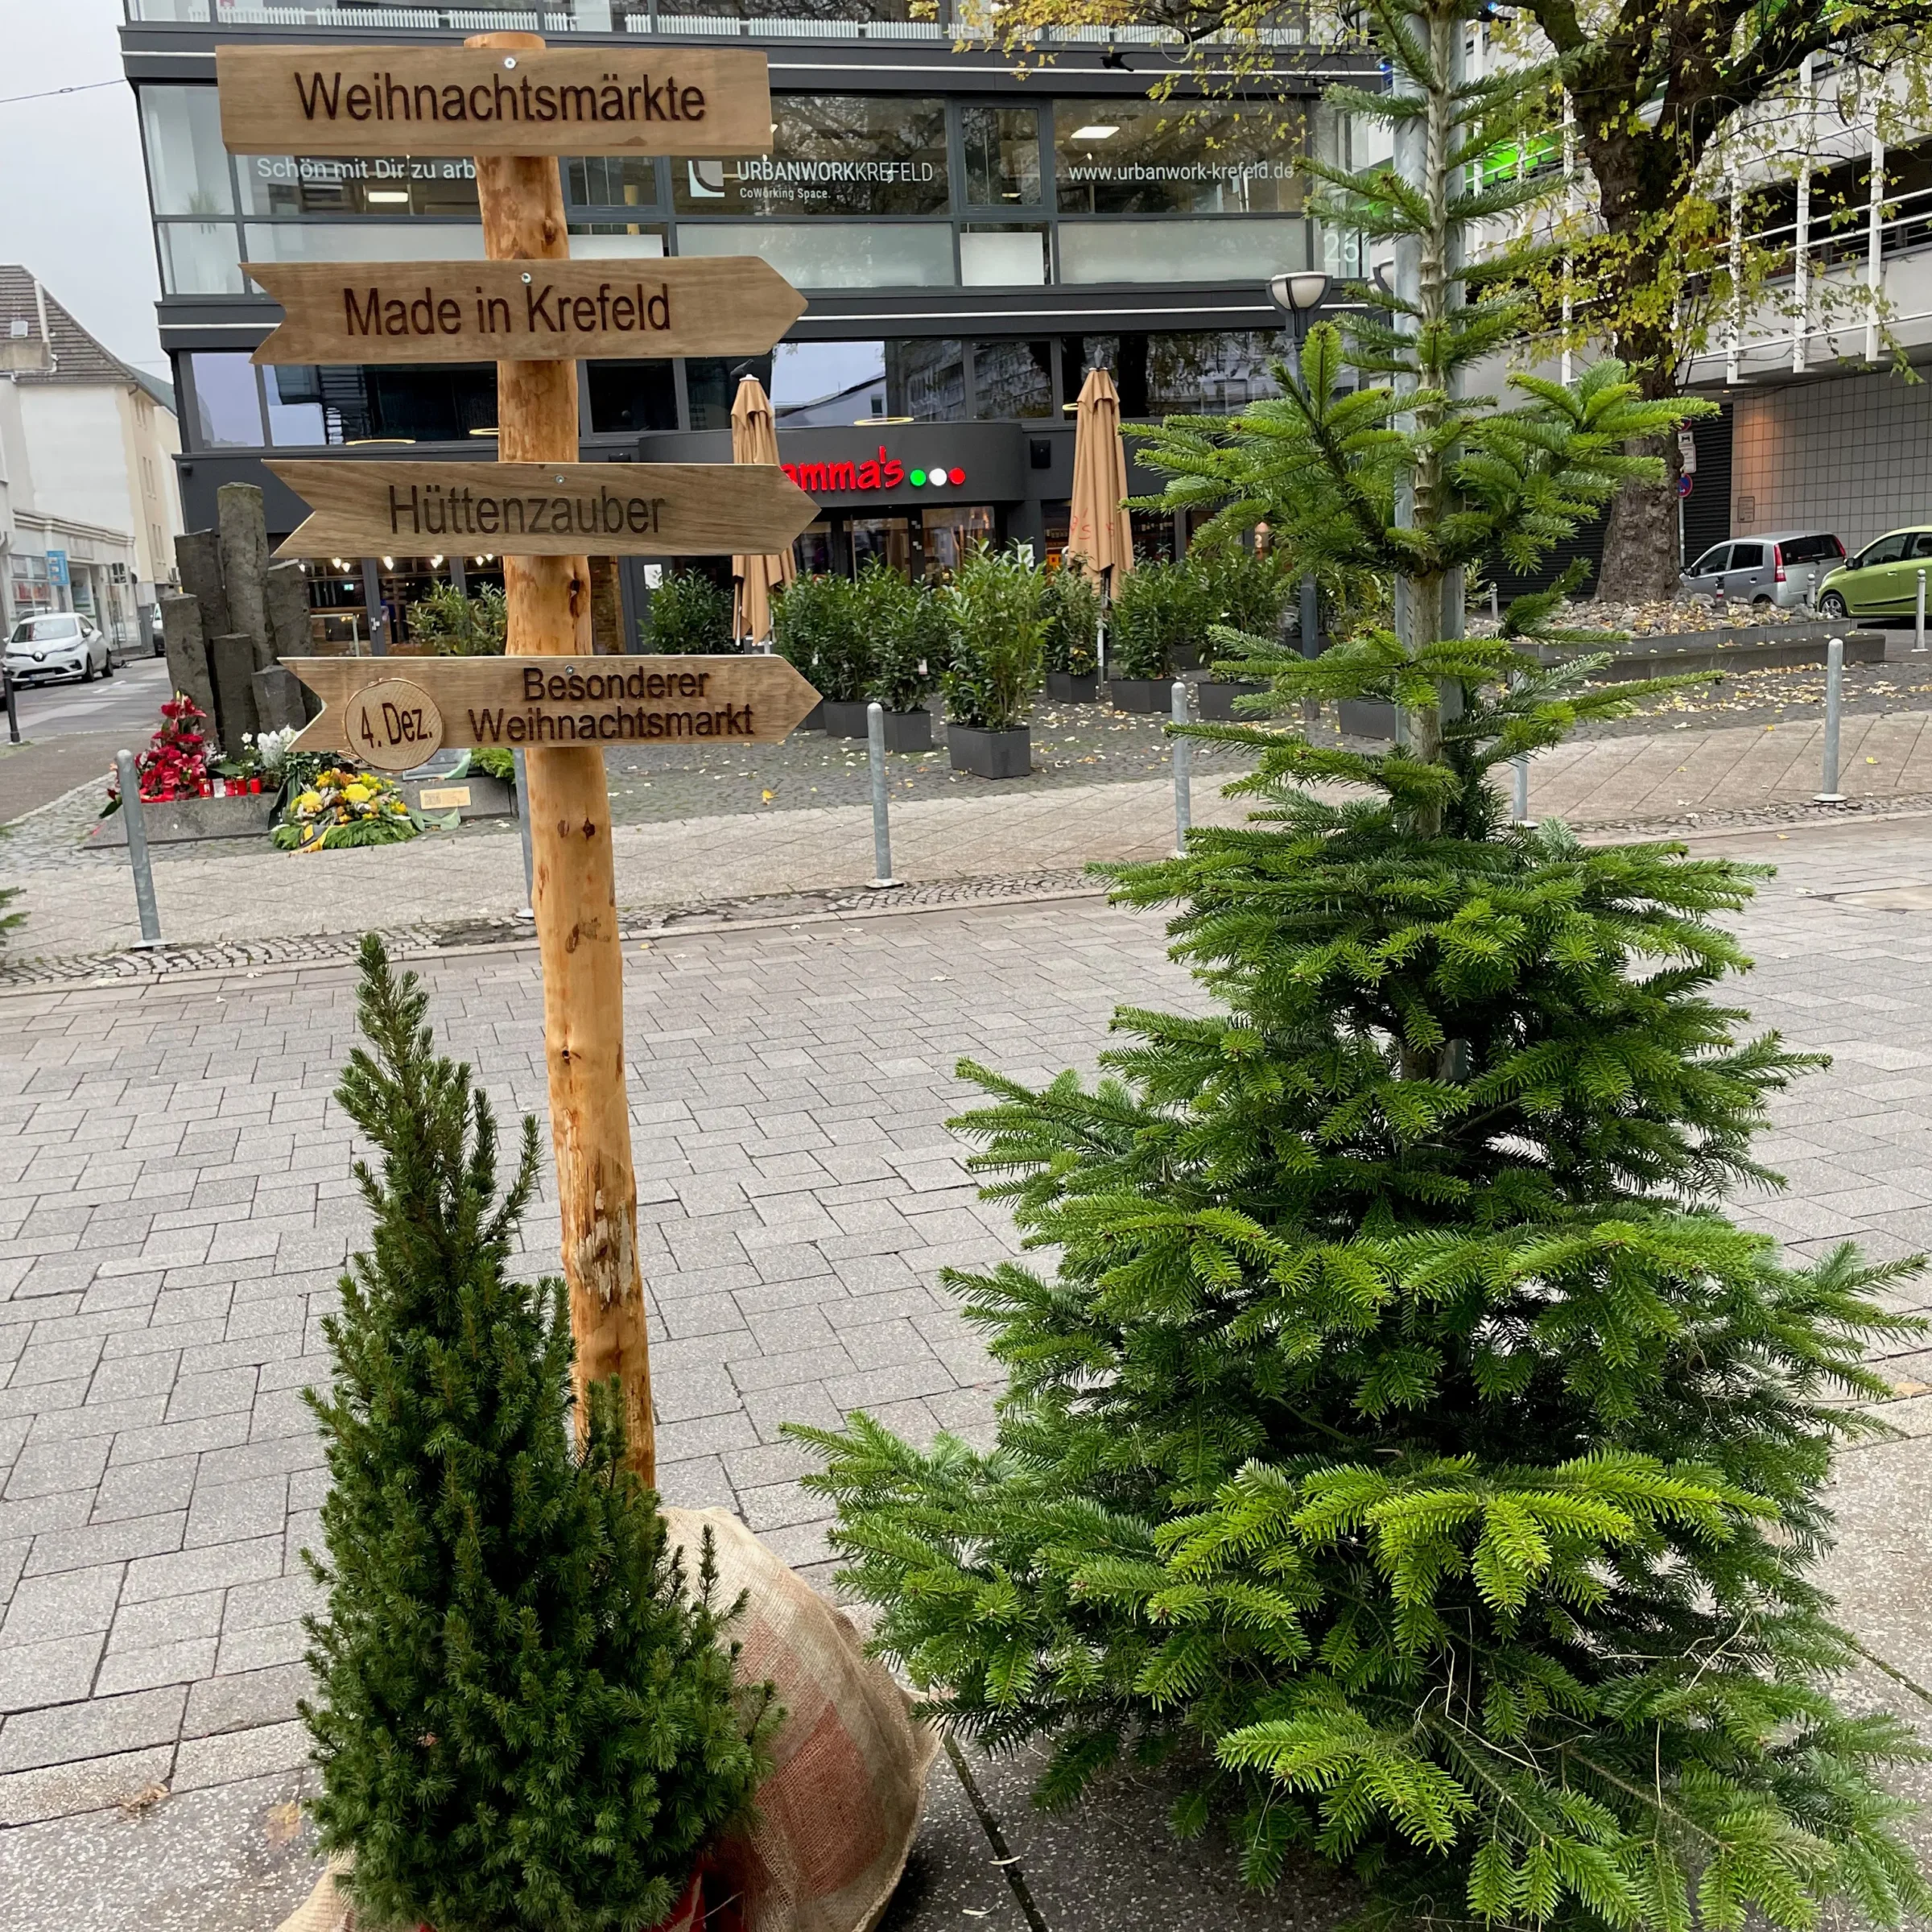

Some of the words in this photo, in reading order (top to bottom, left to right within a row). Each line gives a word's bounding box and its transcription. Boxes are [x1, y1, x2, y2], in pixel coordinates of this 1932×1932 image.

[295, 71, 705, 122] Weihnachtsmärkte
[257, 158, 328, 179] Schön
[335, 158, 369, 179] mit
[375, 159, 405, 179] Dir
[411, 163, 436, 179] zu
[443, 159, 477, 179] arb
[737, 160, 933, 181] URBANWORKKREFELD
[1068, 162, 1294, 180] www.urbanwork-krefeld.de
[797, 187, 831, 200] Space.
[344, 287, 462, 336] Made
[477, 287, 511, 334] in
[525, 283, 671, 332] Krefeld
[780, 445, 905, 491] amma's
[389, 485, 666, 535] Hüttenzauber
[523, 667, 710, 701] Besonderer
[361, 705, 382, 749] 4.
[382, 702, 433, 745] Dez.
[469, 703, 754, 742] Weihnachtsmarkt
